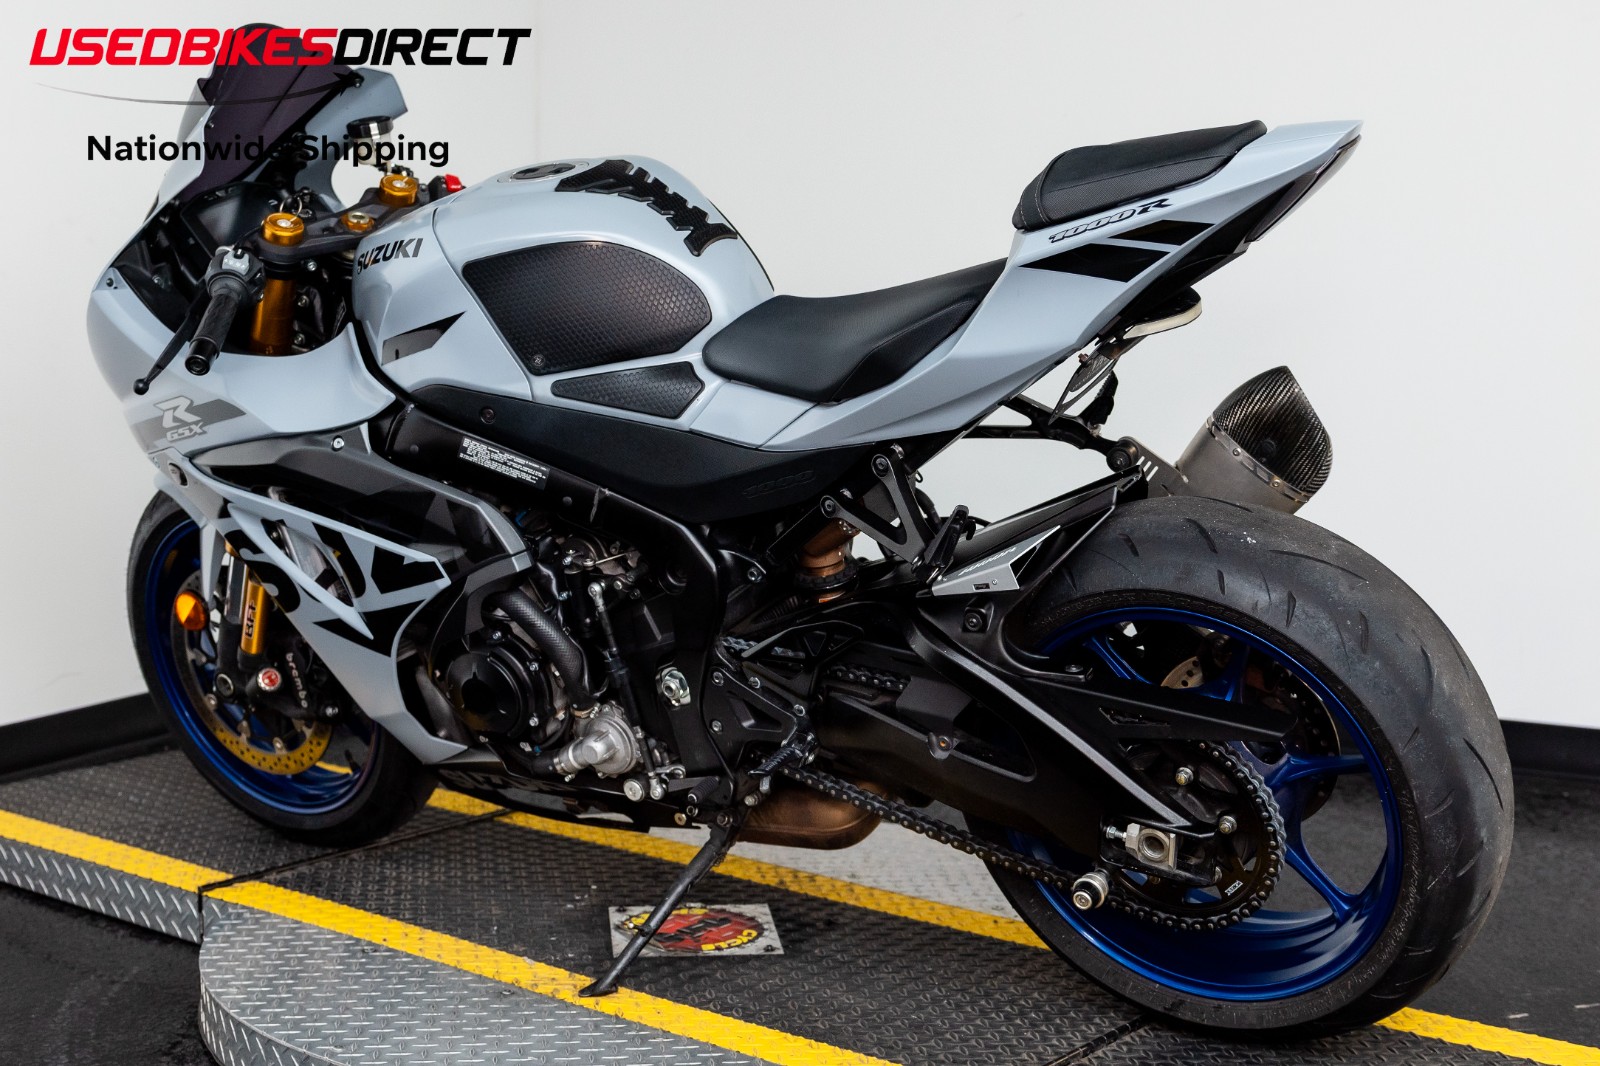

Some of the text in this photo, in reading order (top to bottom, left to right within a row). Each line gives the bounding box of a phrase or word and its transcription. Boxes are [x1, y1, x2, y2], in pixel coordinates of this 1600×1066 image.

[356, 237, 424, 275] SUZUKI
[165, 421, 207, 443] GSX
[285, 651, 309, 709] brembo
